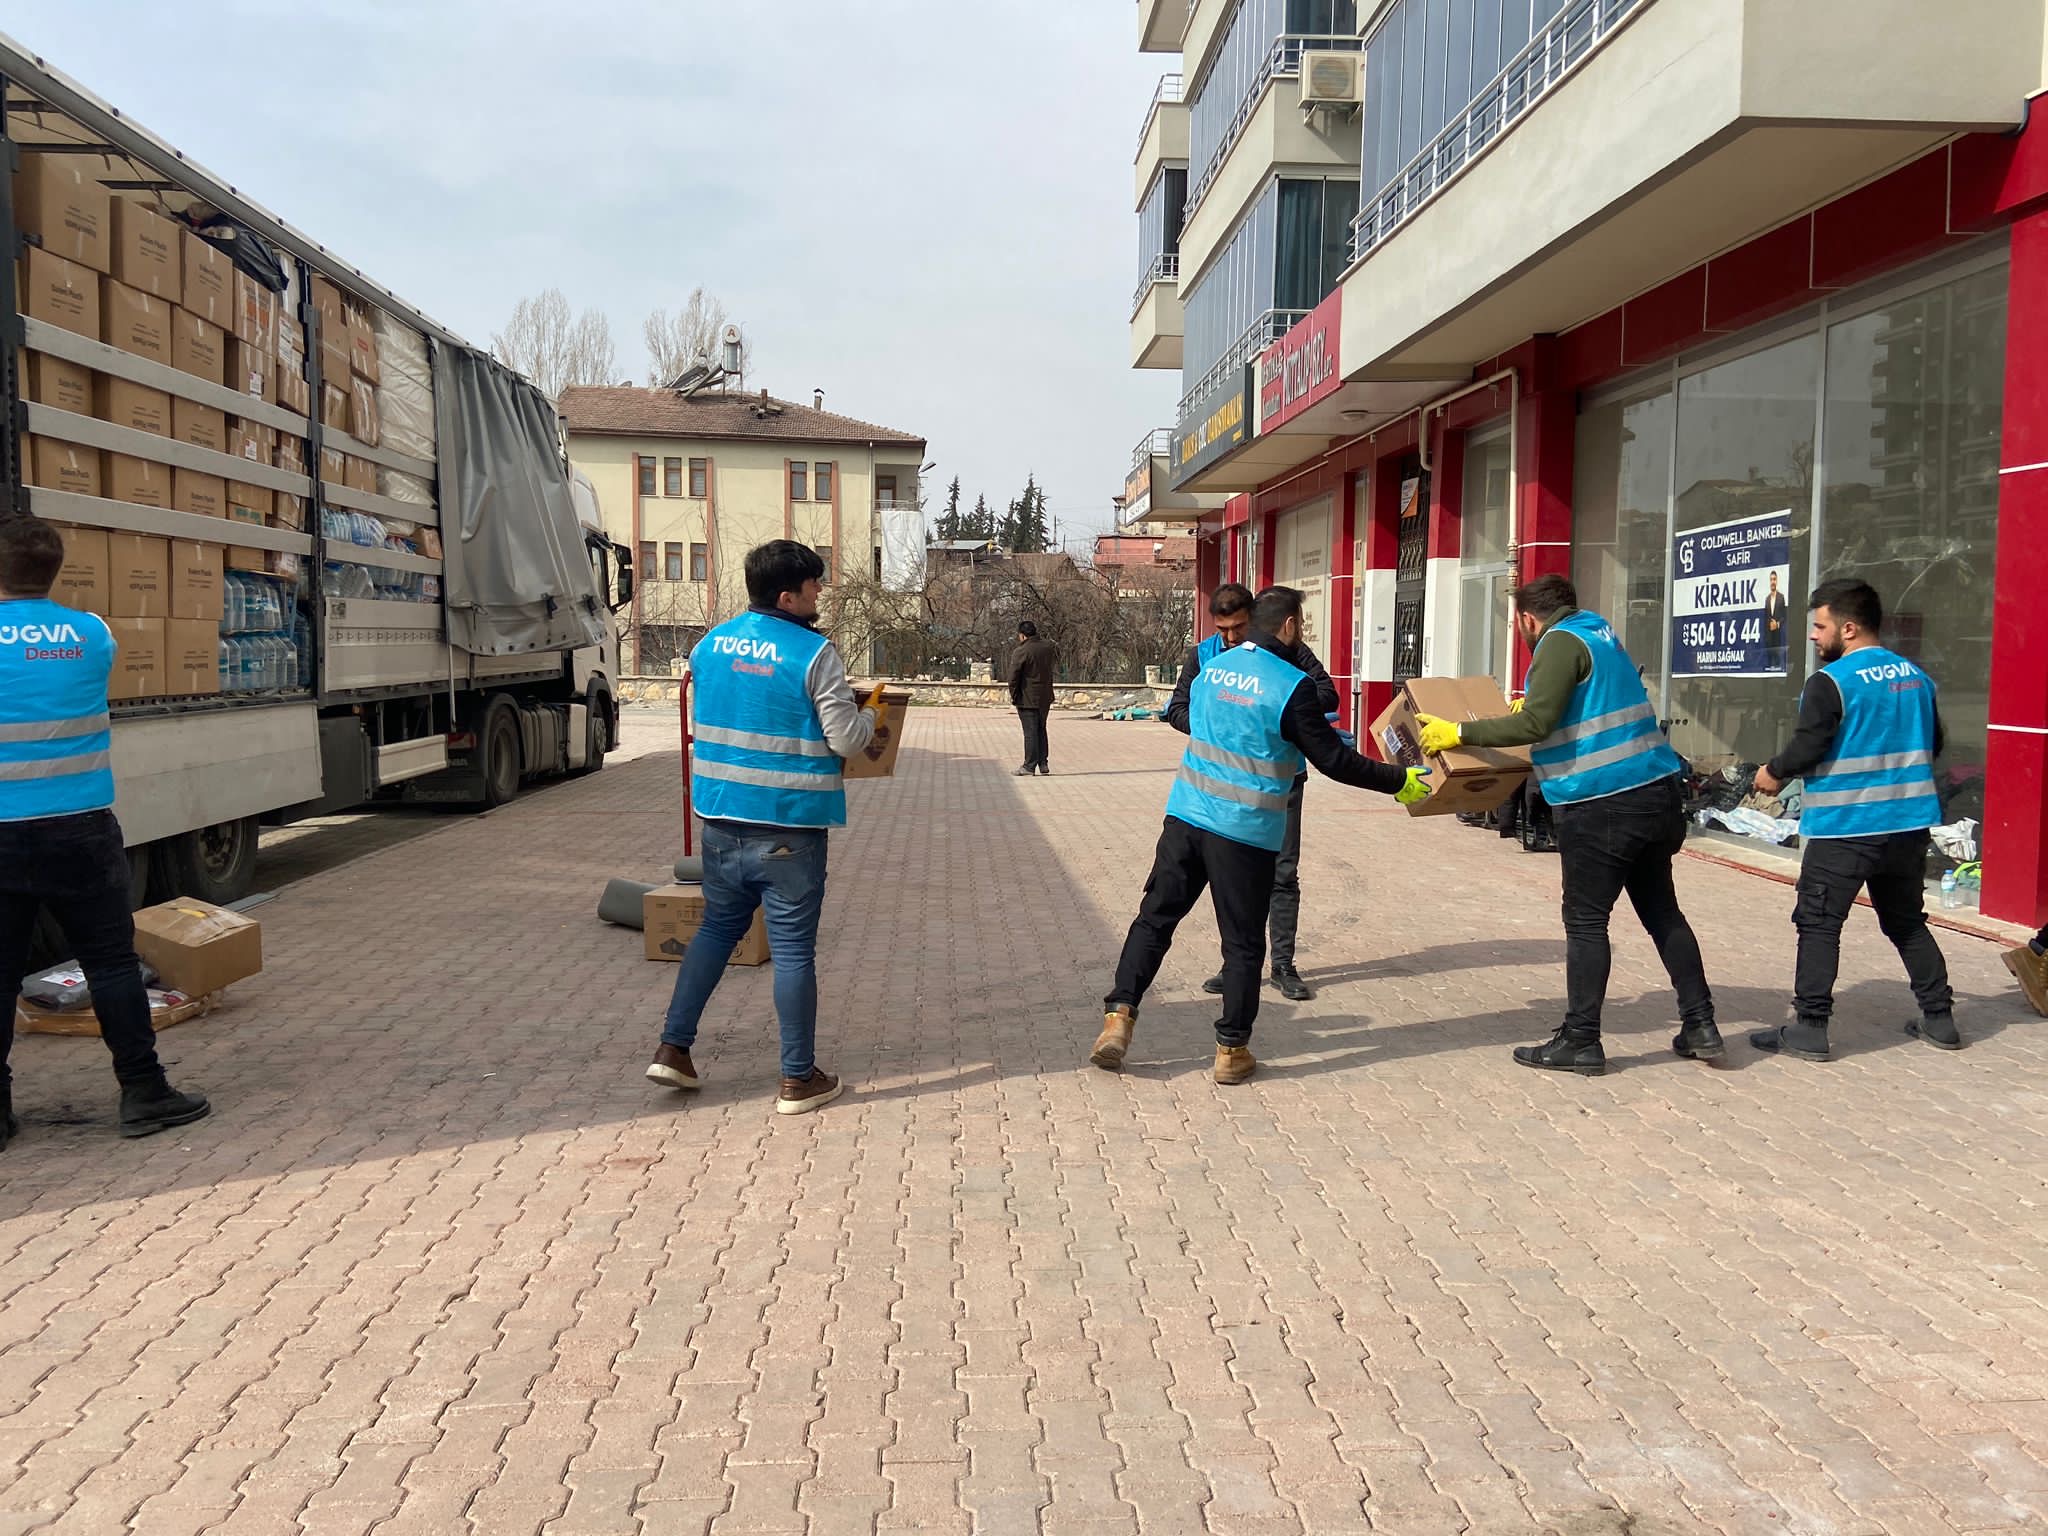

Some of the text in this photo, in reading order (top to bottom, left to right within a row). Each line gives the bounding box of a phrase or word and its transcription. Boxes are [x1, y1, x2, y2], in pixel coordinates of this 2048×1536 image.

[1701, 524, 1783, 551] COLDWELL BANKER
[1726, 549, 1751, 567] SAFİR
[1694, 577, 1758, 609] KİRALIK
[1690, 618, 1761, 647] 504 16 44
[25, 645, 83, 661] Destek
